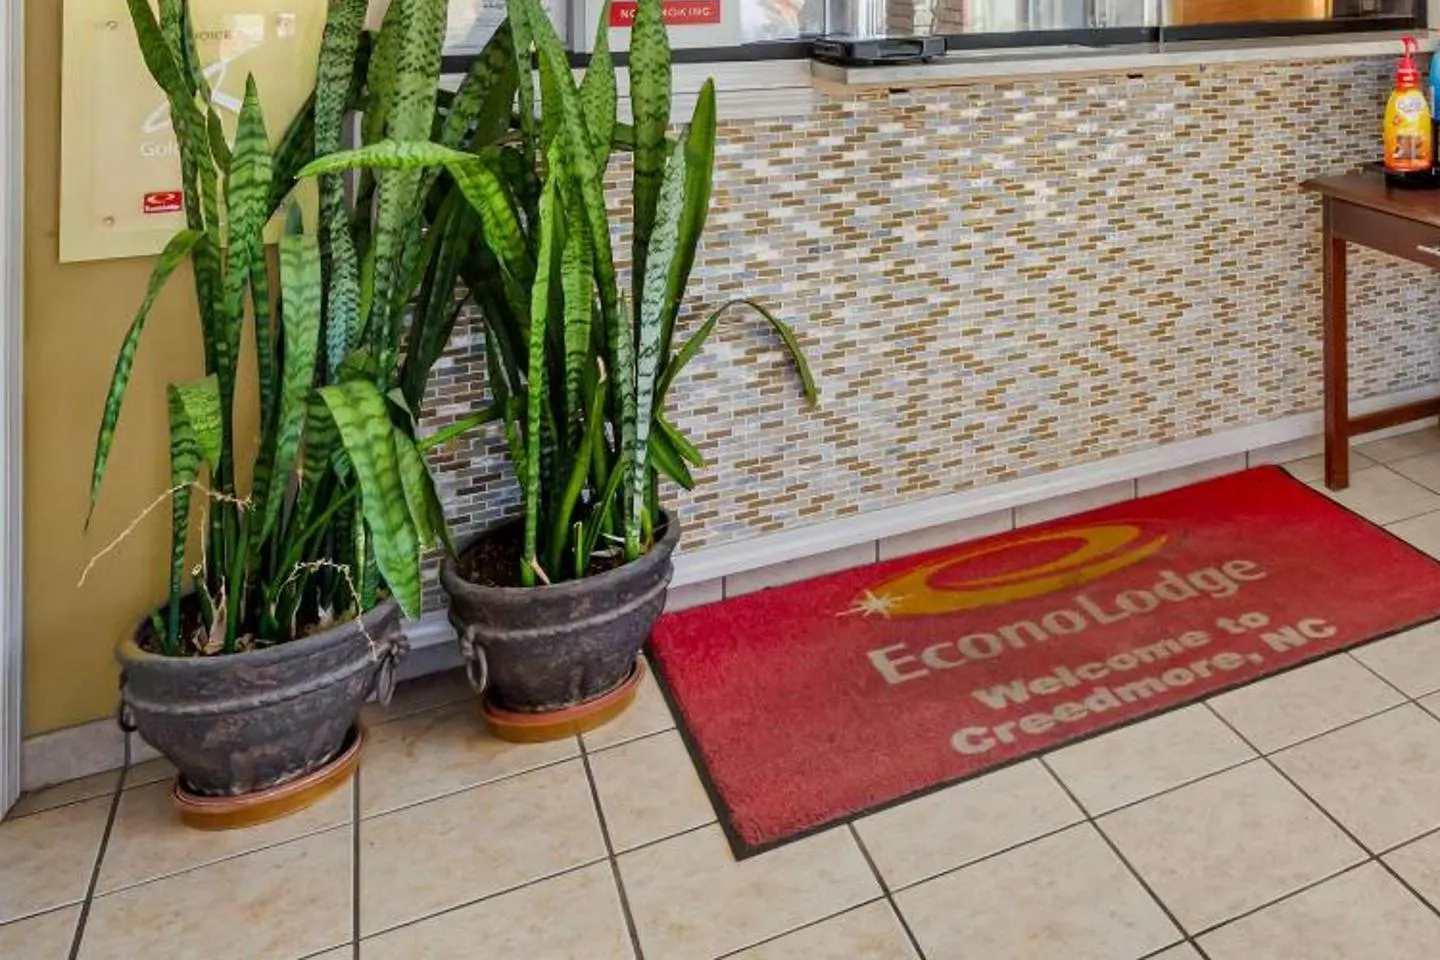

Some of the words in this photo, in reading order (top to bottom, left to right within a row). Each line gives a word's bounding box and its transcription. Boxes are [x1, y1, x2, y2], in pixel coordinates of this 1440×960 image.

[950, 647, 1264, 755] Creedmore,
[1260, 617, 1338, 654] NC
[971, 628, 1212, 709] Welcome
[1216, 610, 1271, 636] to
